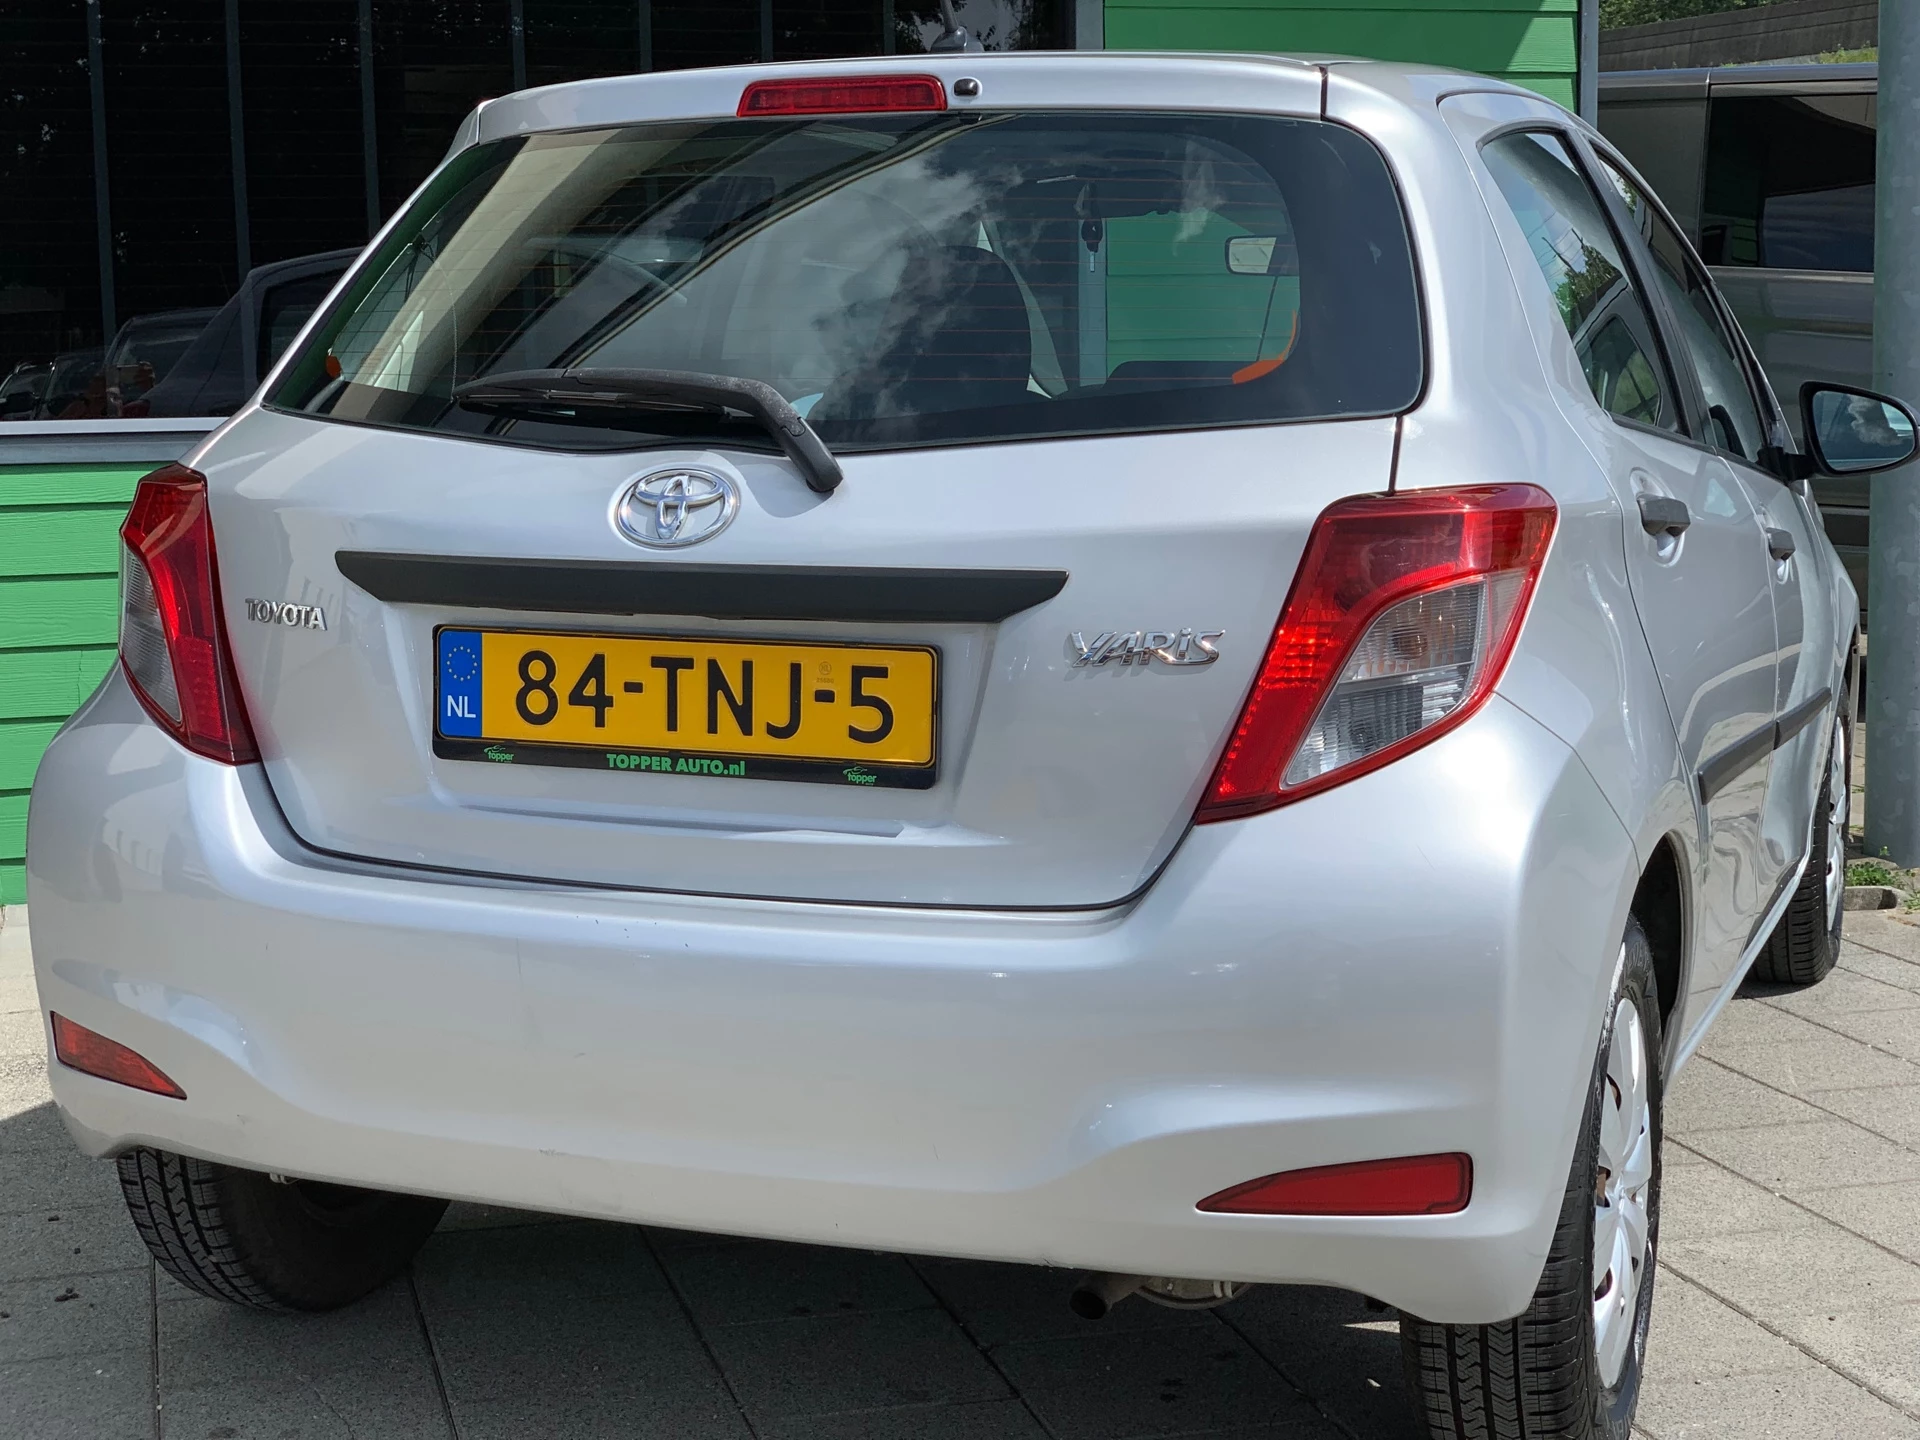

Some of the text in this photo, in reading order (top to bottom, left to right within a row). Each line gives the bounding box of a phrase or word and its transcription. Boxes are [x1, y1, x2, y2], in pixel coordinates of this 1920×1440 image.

[245, 598, 327, 631] TOYOTA
[447, 694, 477, 719] NL
[515, 649, 895, 744] 84-TNJ-5
[488, 750, 515, 762] topper
[606, 753, 746, 776] TOPPER AUTO.nl
[847, 771, 878, 785] topper
